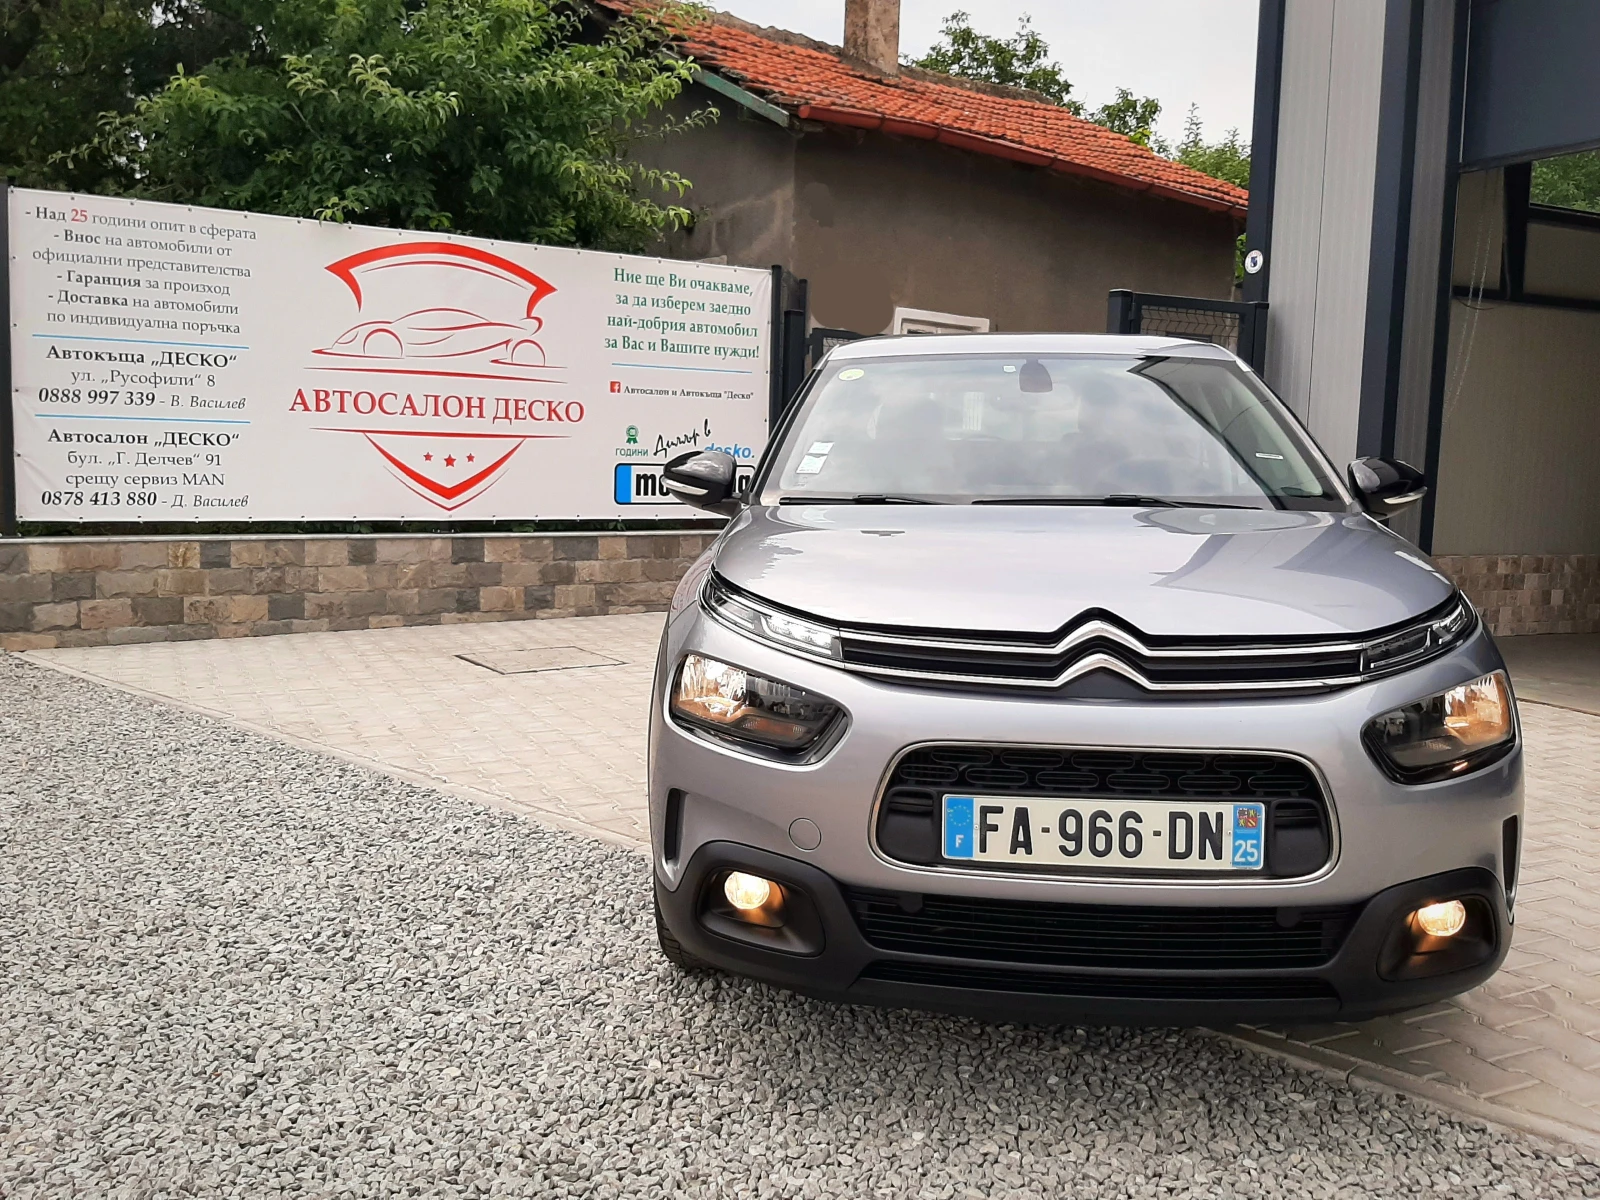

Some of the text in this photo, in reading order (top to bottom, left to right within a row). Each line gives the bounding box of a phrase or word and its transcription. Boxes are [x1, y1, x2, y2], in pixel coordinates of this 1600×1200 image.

[36, 206, 66, 222] Над
[71, 209, 88, 222] 25
[92, 214, 146, 229] години
[150, 221, 186, 233] опит
[189, 225, 196, 233] в
[200, 223, 256, 241] сферата
[64, 229, 100, 244] Внос
[105, 237, 122, 246] на
[127, 238, 212, 256] автомобили
[217, 247, 232, 257] от
[32, 248, 250, 278] официални представителства
[67, 270, 140, 288] Гаранция
[145, 280, 159, 289] за
[164, 281, 230, 296] произход
[614, 268, 753, 296] Ние ще Ви очакваме,
[57, 290, 128, 306] Доставка
[133, 298, 149, 308] на
[154, 299, 238, 314] автомобили
[616, 294, 751, 316] за да изберем заедно
[47, 312, 240, 334] по индивидуална поръчка
[607, 315, 758, 337] най-добрия автомобил
[46, 346, 144, 364] Автокъща
[604, 336, 759, 360] за Вас и Вашите нужди!
[71, 371, 95, 384] ул.
[207, 375, 215, 387] 8
[39, 388, 81, 403] 0888
[87, 390, 119, 404] 997
[124, 392, 155, 406] 339
[170, 395, 184, 407] В.
[190, 396, 246, 409] Василев
[624, 386, 669, 396] Автосалон
[680, 389, 722, 398] Автокъща
[289, 388, 584, 425] АВТОСАЛОН ДЕСКО
[48, 429, 148, 444] Автосалон
[68, 451, 102, 467] бул.
[206, 454, 221, 466] 91
[615, 448, 648, 457] ГОДИНИ
[66, 473, 224, 488] срещу сервиз MAN
[42, 491, 84, 506] 0878
[90, 492, 120, 506] 413
[126, 492, 157, 506] 880
[171, 495, 187, 508] Д.
[193, 496, 248, 508] Василев
[956, 805, 1258, 862] F FA-966-DN 25
